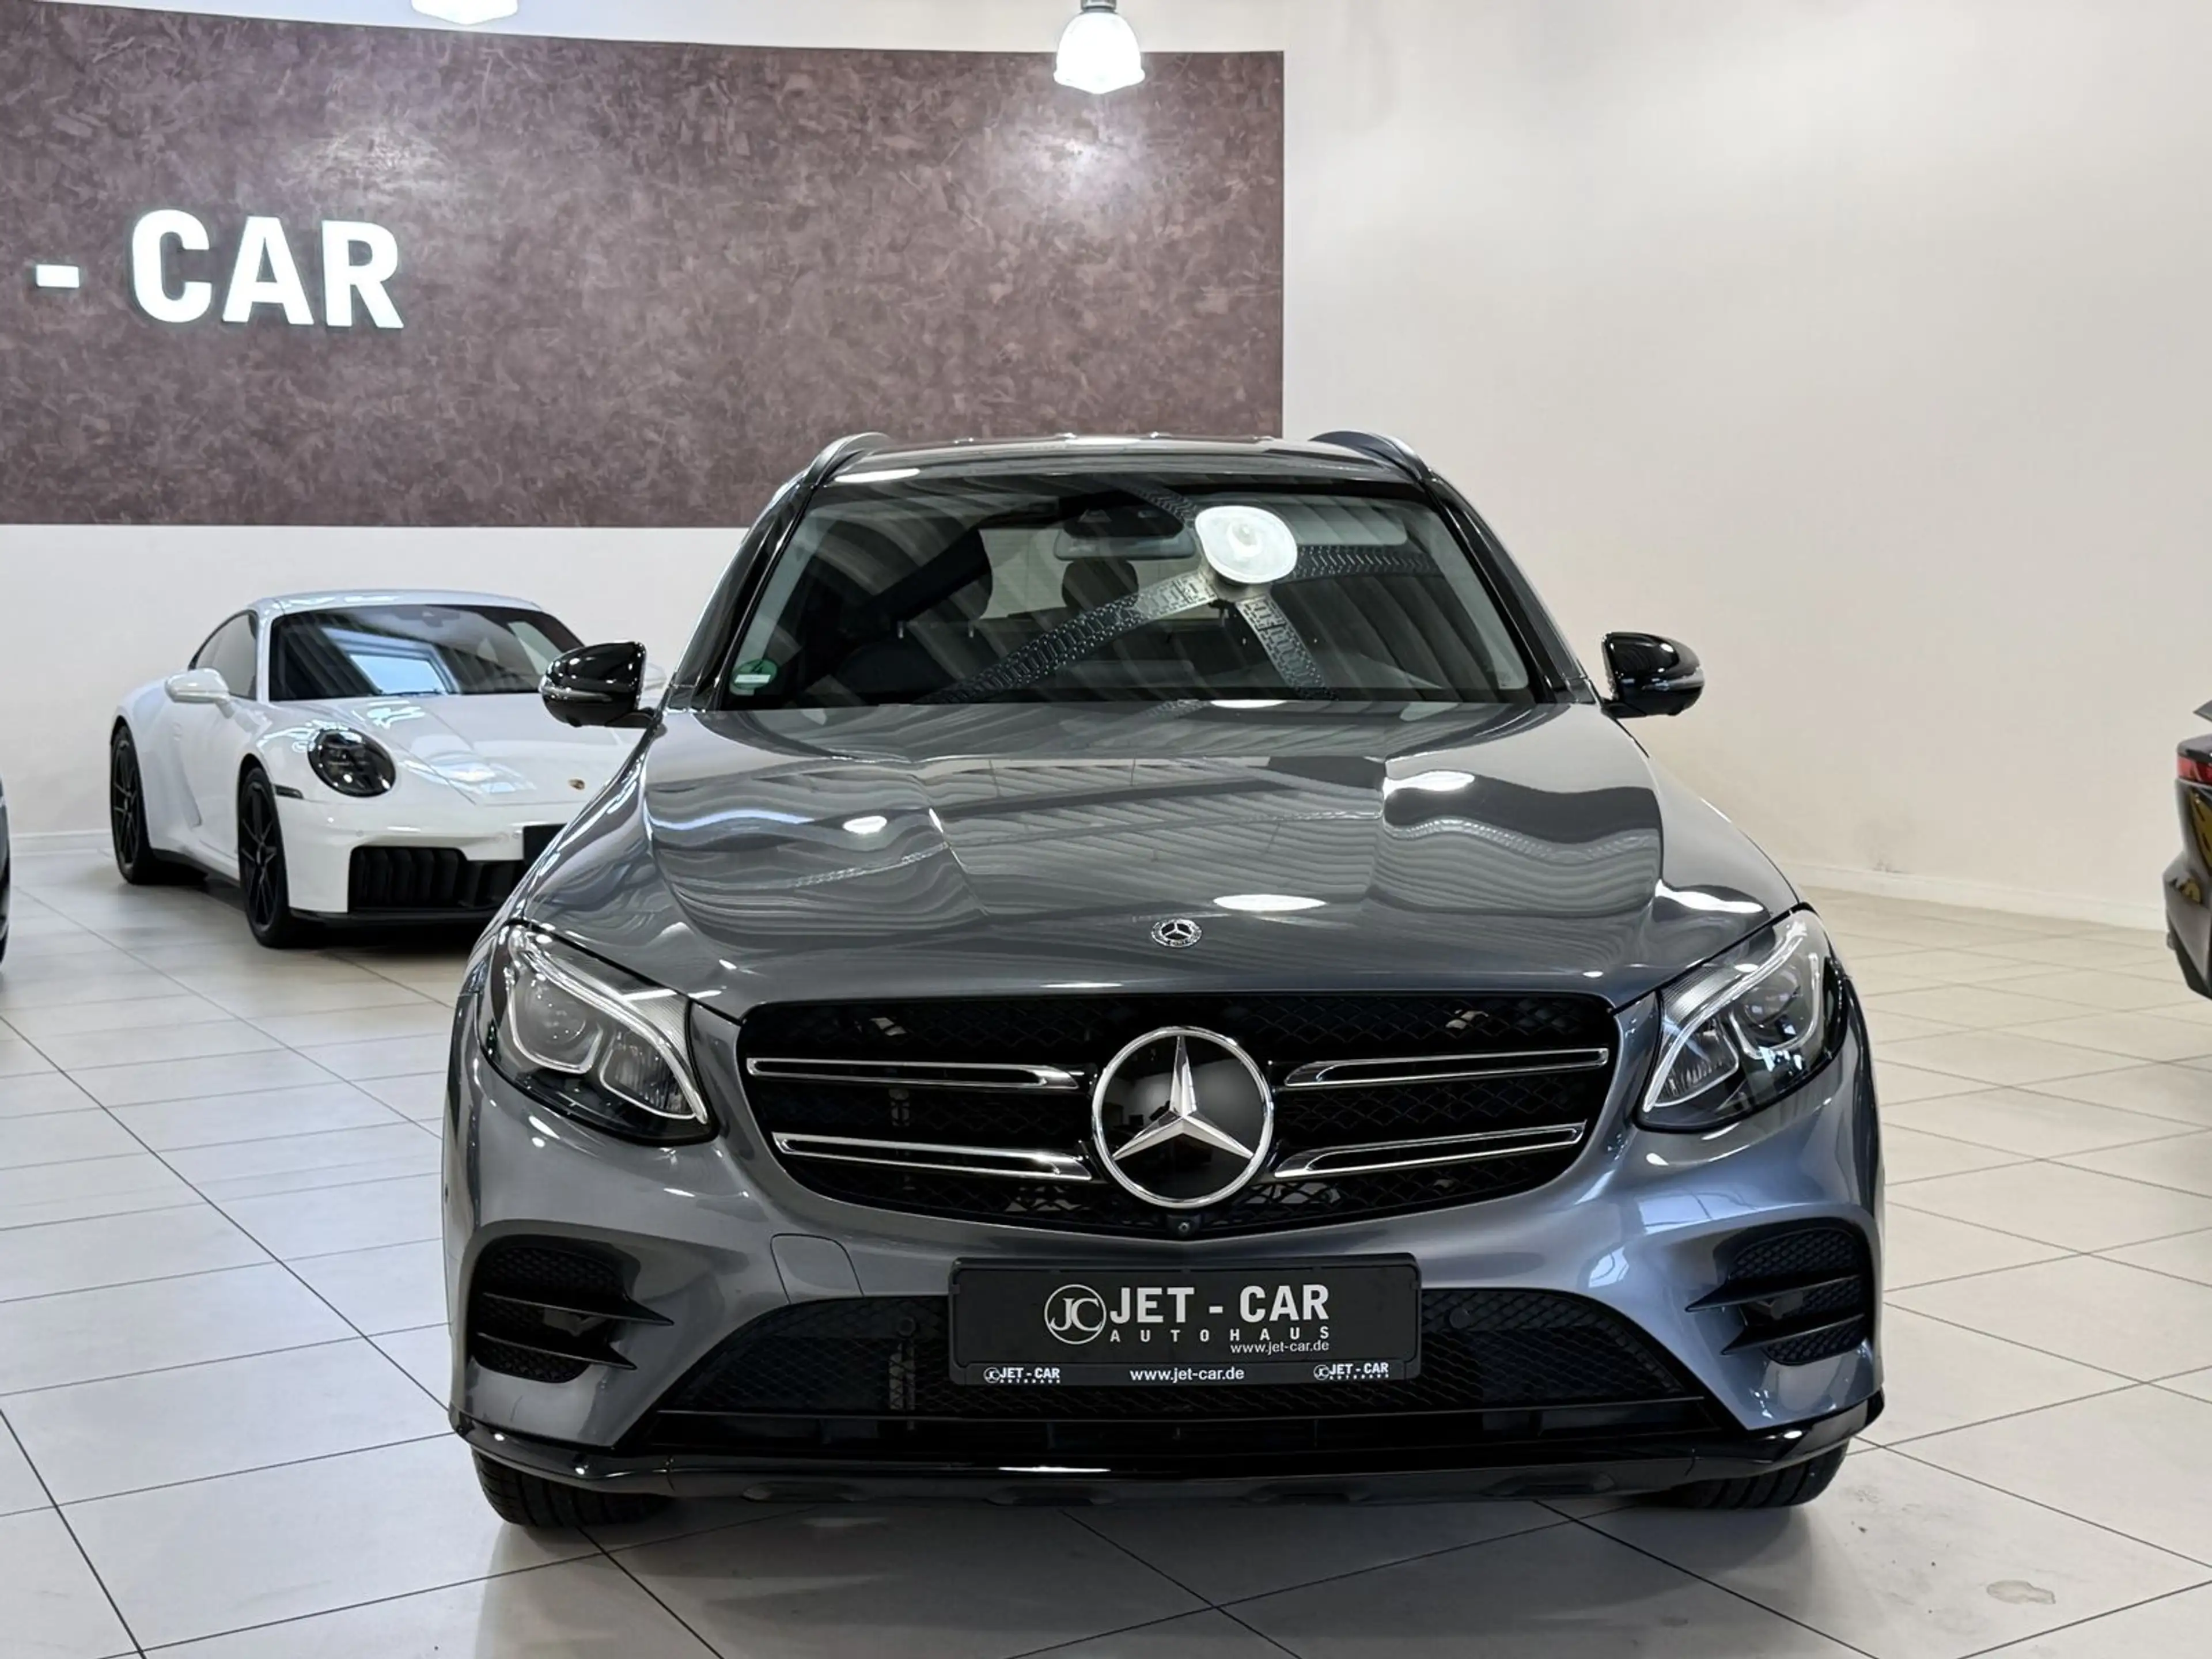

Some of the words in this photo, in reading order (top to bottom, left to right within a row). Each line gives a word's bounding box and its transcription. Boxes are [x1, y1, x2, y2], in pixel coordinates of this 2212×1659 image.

[36, 264, 79, 288] -
[132, 209, 404, 328] CAR
[1109, 1286, 1195, 1324] JET
[1209, 1306, 1224, 1314] -
[1240, 1284, 1330, 1323] CAR
[1230, 1339, 1330, 1355] www.jet-car.de
[999, 1366, 1024, 1378] JET
[1035, 1367, 1060, 1378] CAR
[1129, 1366, 1245, 1383] www.jet-car.de
[1329, 1363, 1353, 1375] JET
[1363, 1362, 1389, 1374] CAR
